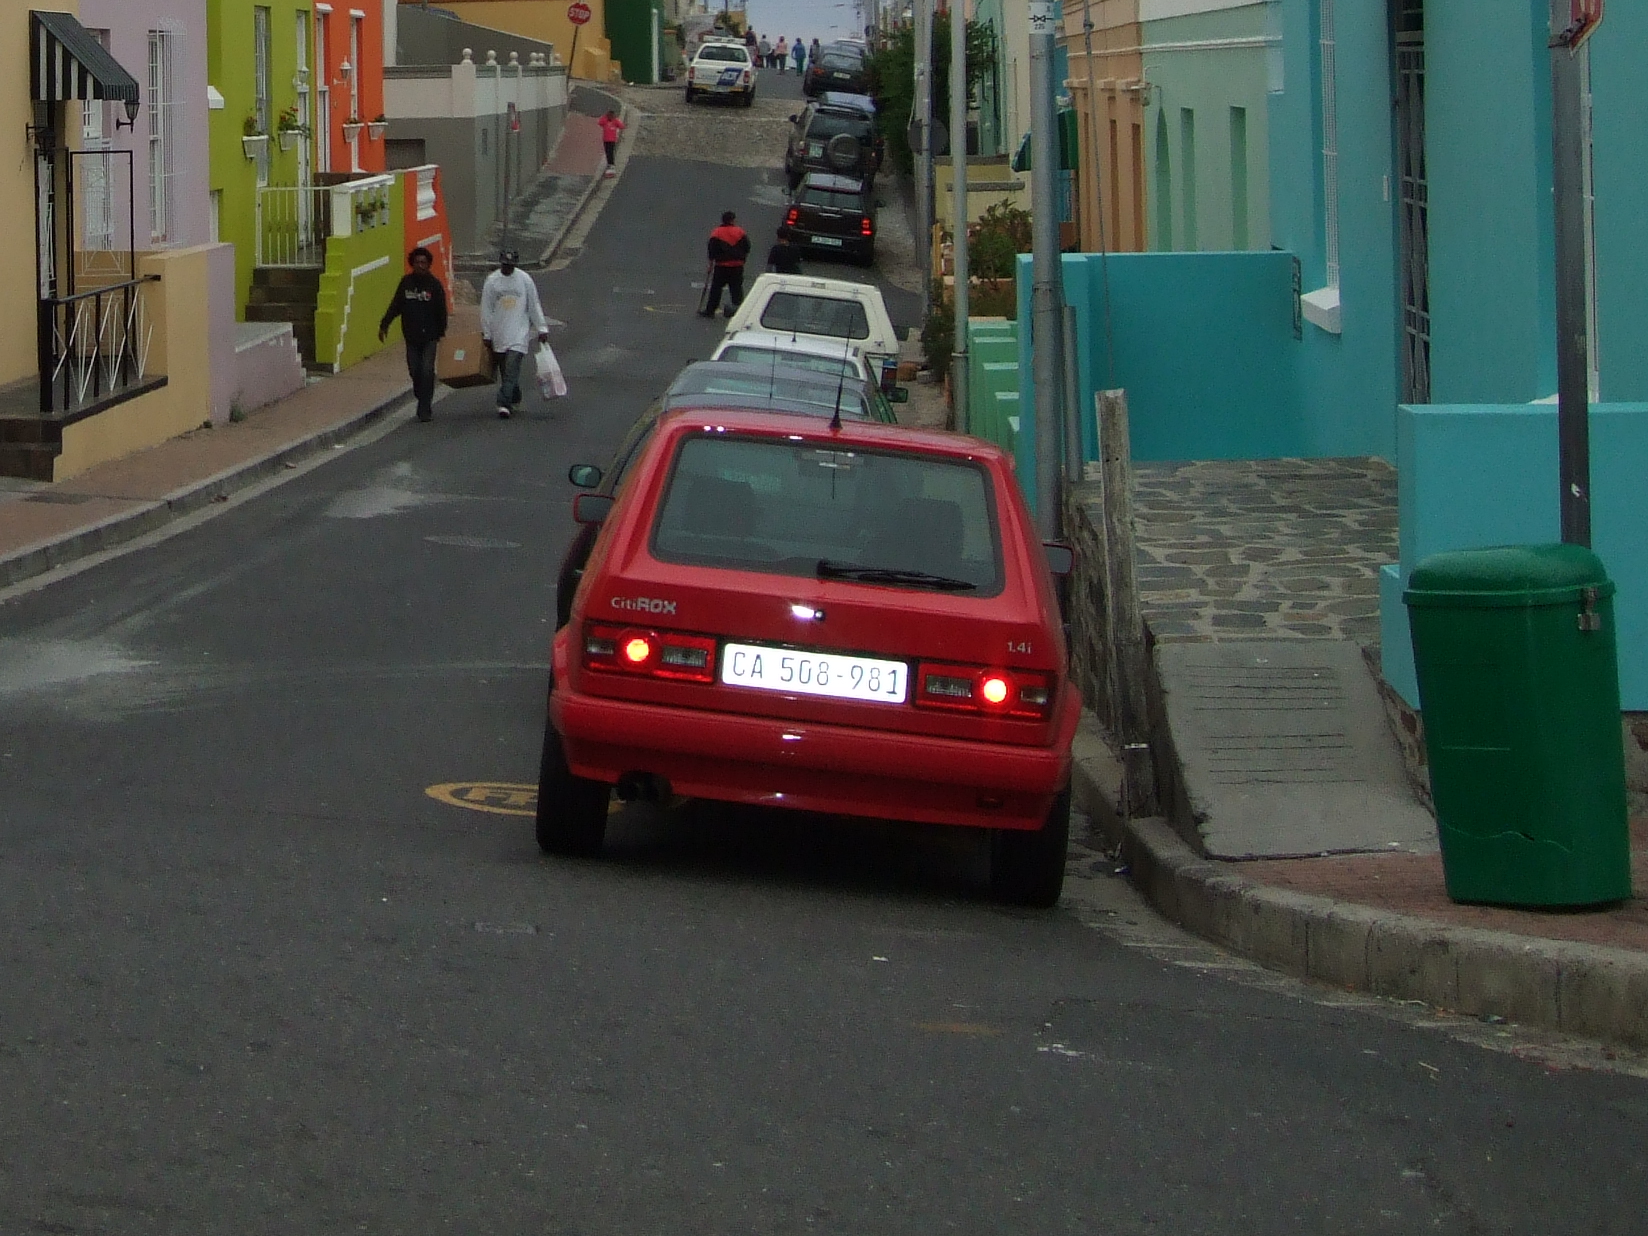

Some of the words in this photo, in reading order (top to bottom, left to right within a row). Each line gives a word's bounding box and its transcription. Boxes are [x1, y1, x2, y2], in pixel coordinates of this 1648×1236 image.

[569, 7, 590, 19] STOP
[1008, 641, 1031, 654] 1.4i
[733, 651, 763, 679] CA
[780, 657, 898, 695] 508-981
